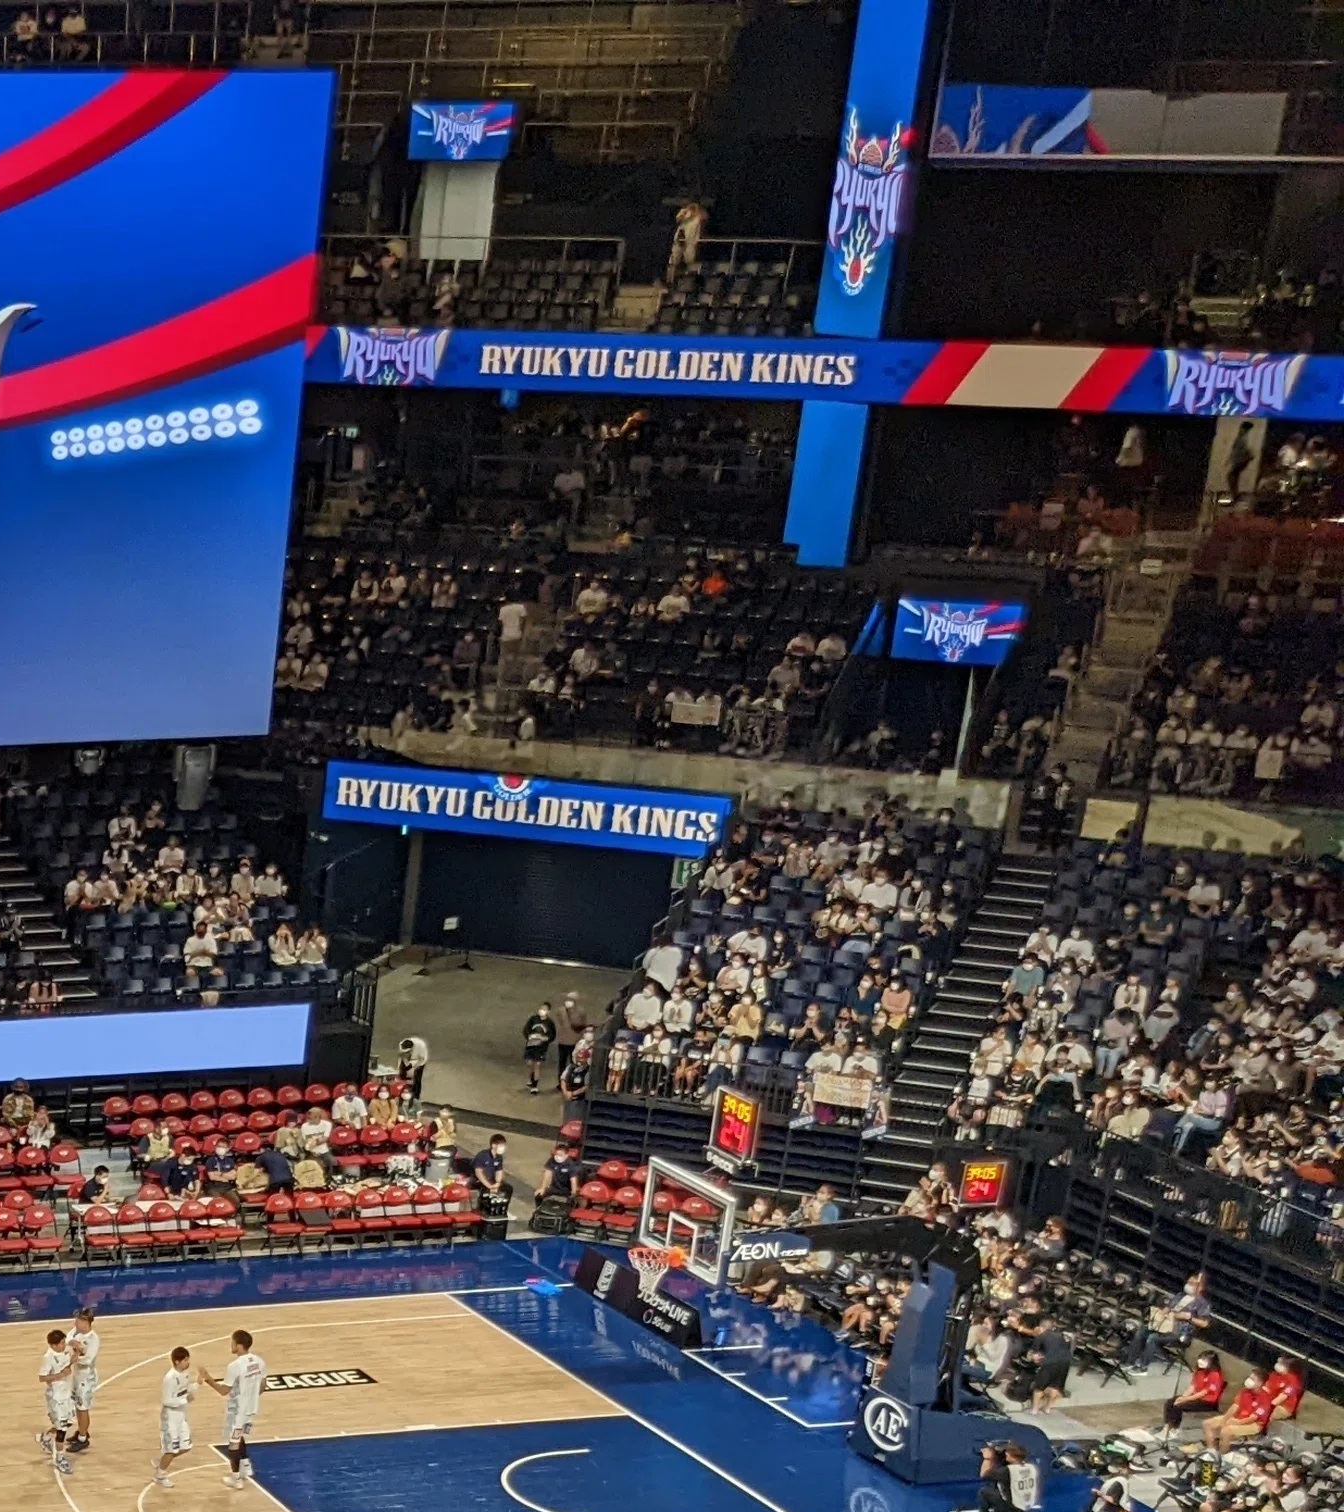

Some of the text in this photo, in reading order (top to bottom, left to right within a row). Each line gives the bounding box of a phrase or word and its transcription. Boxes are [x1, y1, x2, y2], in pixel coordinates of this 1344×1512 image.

[478, 344, 856, 386] RYUKYU GOLDEN KINGS
[336, 777, 720, 844] RYUKYU GOLDEN KINGS
[264, 1370, 369, 1391] EAGUE
